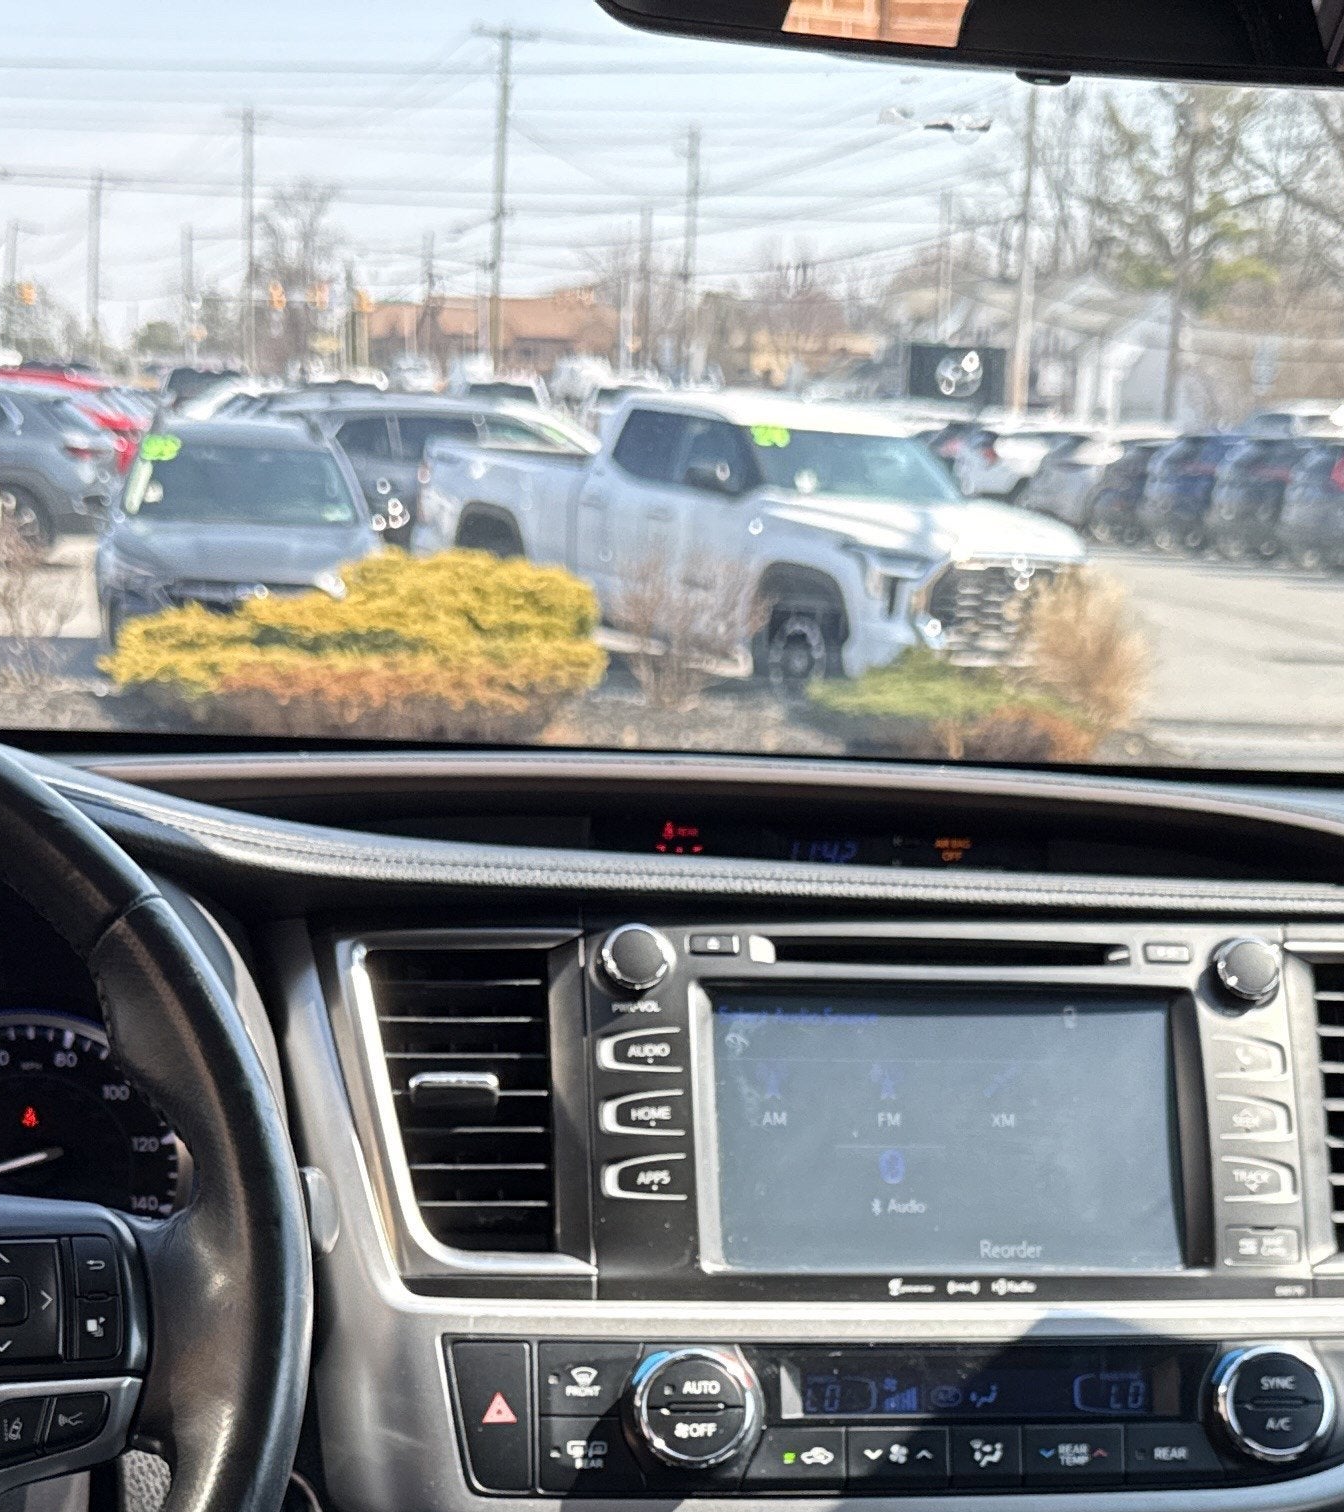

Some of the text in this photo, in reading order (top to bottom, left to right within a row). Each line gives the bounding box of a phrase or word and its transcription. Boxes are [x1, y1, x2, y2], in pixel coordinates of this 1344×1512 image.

[627, 1043, 671, 1058] AUDIO
[54, 1051, 78, 1068] 80
[102, 1084, 131, 1101] 100
[630, 1106, 672, 1121] HOME
[762, 1113, 788, 1127] AM
[877, 1113, 903, 1128] FM
[992, 1114, 1016, 1129] XM
[131, 1136, 159, 1152] 120
[636, 1170, 671, 1186] APPS
[131, 1195, 159, 1211] 140
[887, 1200, 927, 1214] Audio
[979, 1240, 1043, 1259] Reorder
[682, 1380, 721, 1395] AUTO
[1260, 1375, 1296, 1391] SYNC
[565, 1386, 601, 1397] FRONT
[690, 1423, 718, 1438] OFF
[1265, 1416, 1293, 1432] A/C
[1058, 1443, 1089, 1455] REAR
[1153, 1446, 1188, 1460] REAR
[574, 1457, 605, 1469] REAR
[1060, 1454, 1090, 1466] TEMP
